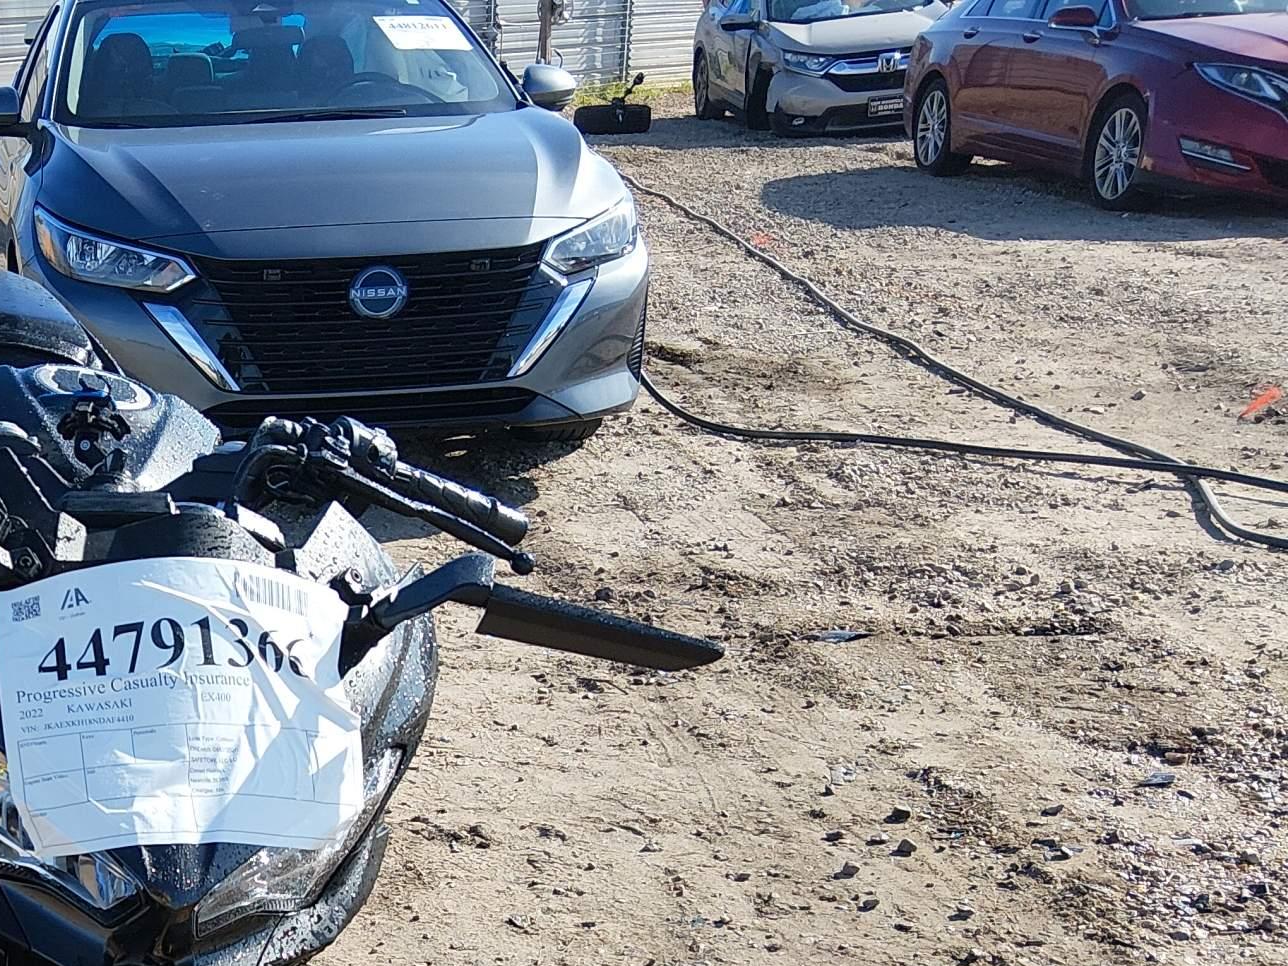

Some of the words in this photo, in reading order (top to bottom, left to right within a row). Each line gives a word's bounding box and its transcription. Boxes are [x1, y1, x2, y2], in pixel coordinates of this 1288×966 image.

[352, 287, 406, 298] NISSAN
[16, 681, 106, 704] Progressive
[111, 671, 178, 692] Casualty
[183, 671, 250, 687] Insurance
[19, 708, 44, 720] 2022
[67, 698, 133, 714] KAWASAKI
[201, 692, 231, 702] EX400
